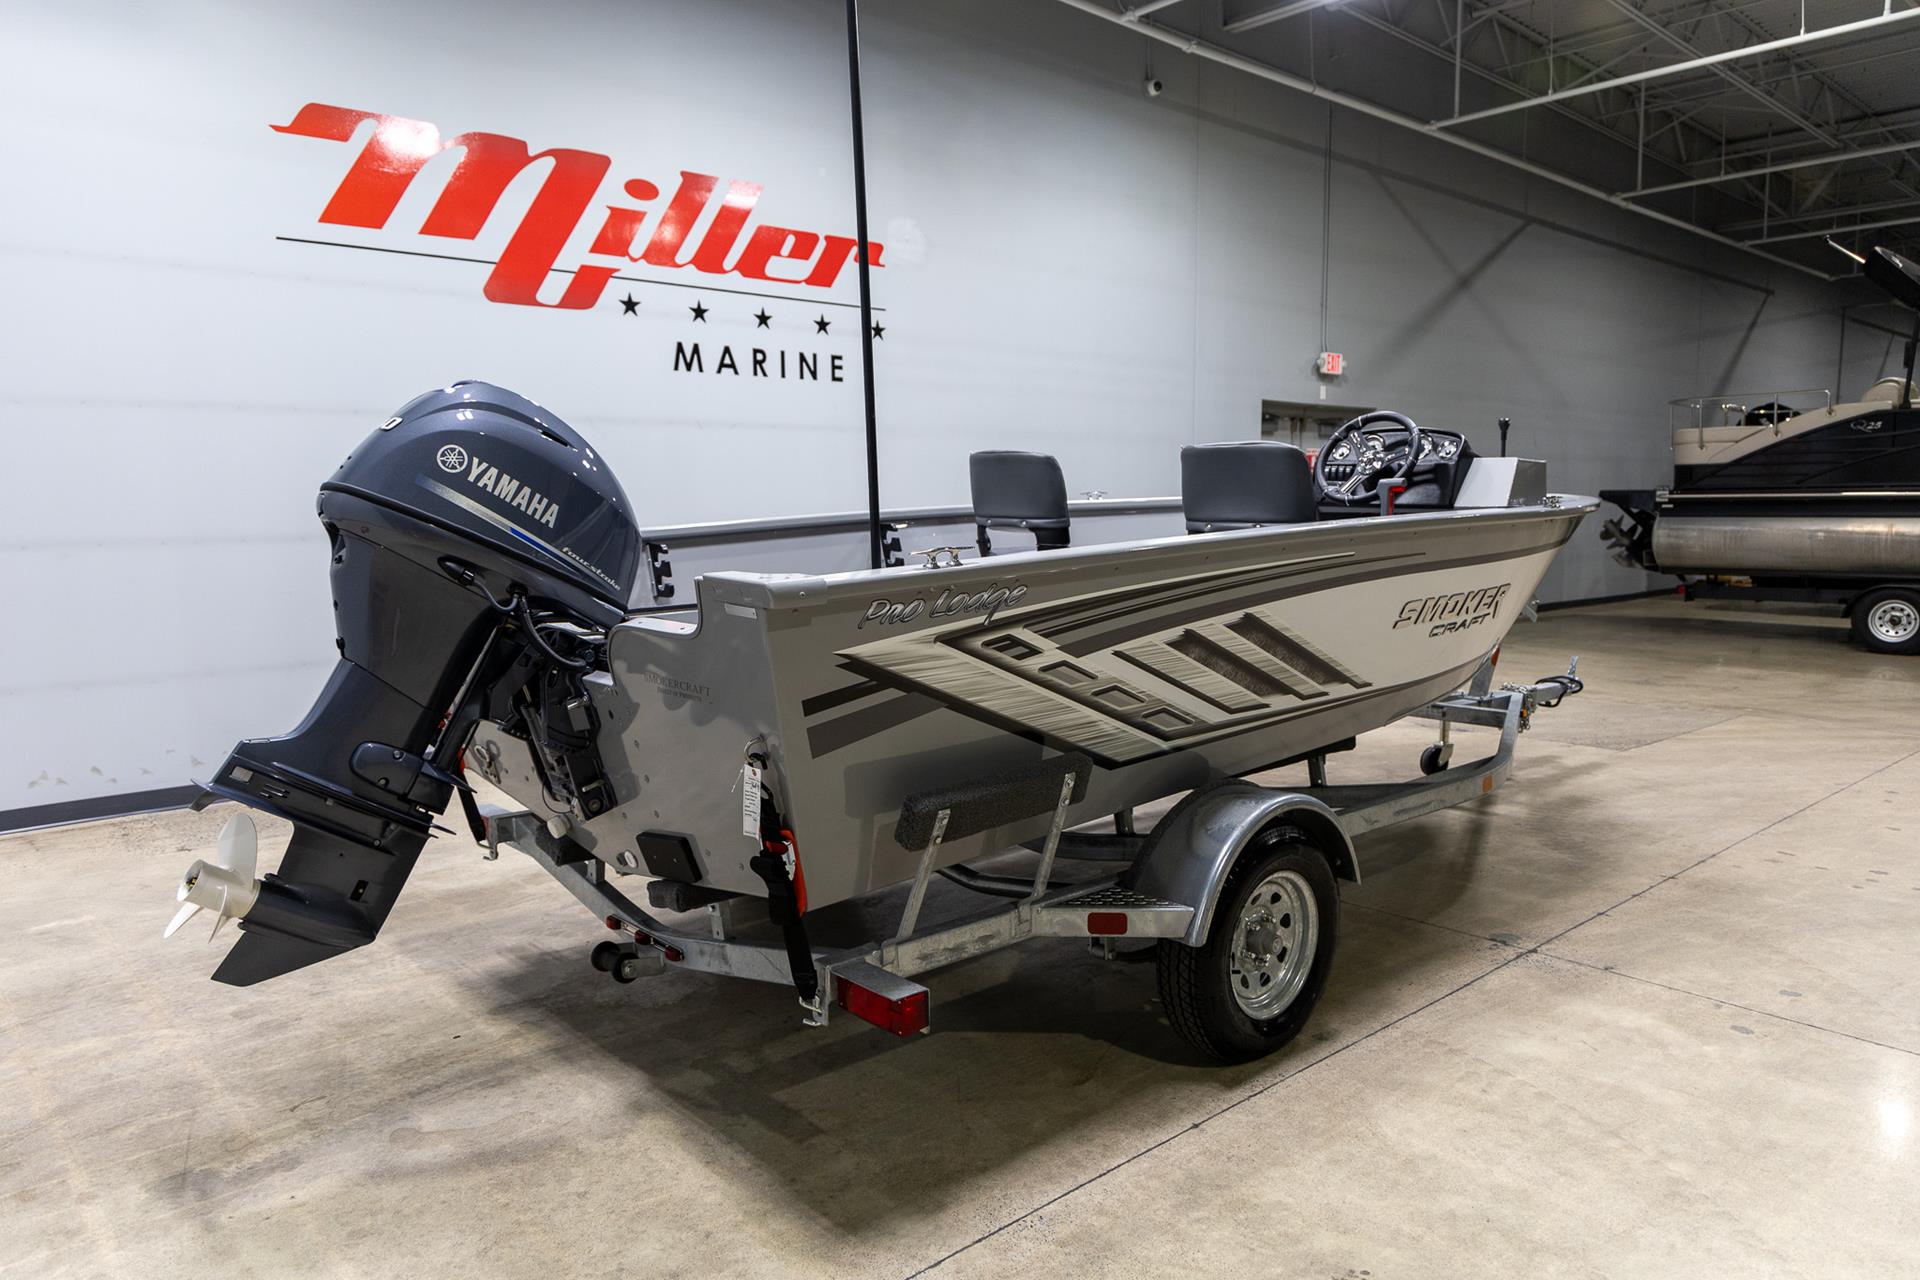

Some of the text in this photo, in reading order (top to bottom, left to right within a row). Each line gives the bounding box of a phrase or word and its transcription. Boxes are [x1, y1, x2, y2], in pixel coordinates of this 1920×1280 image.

[269, 102, 886, 310] Miller
[673, 341, 844, 382] MARINE
[1327, 353, 1341, 372] EXIT
[468, 456, 560, 529] YAMAHA
[929, 582, 1028, 626] Lodge
[1392, 583, 1511, 629] SMOKER
[1429, 612, 1491, 638] CRAFT
